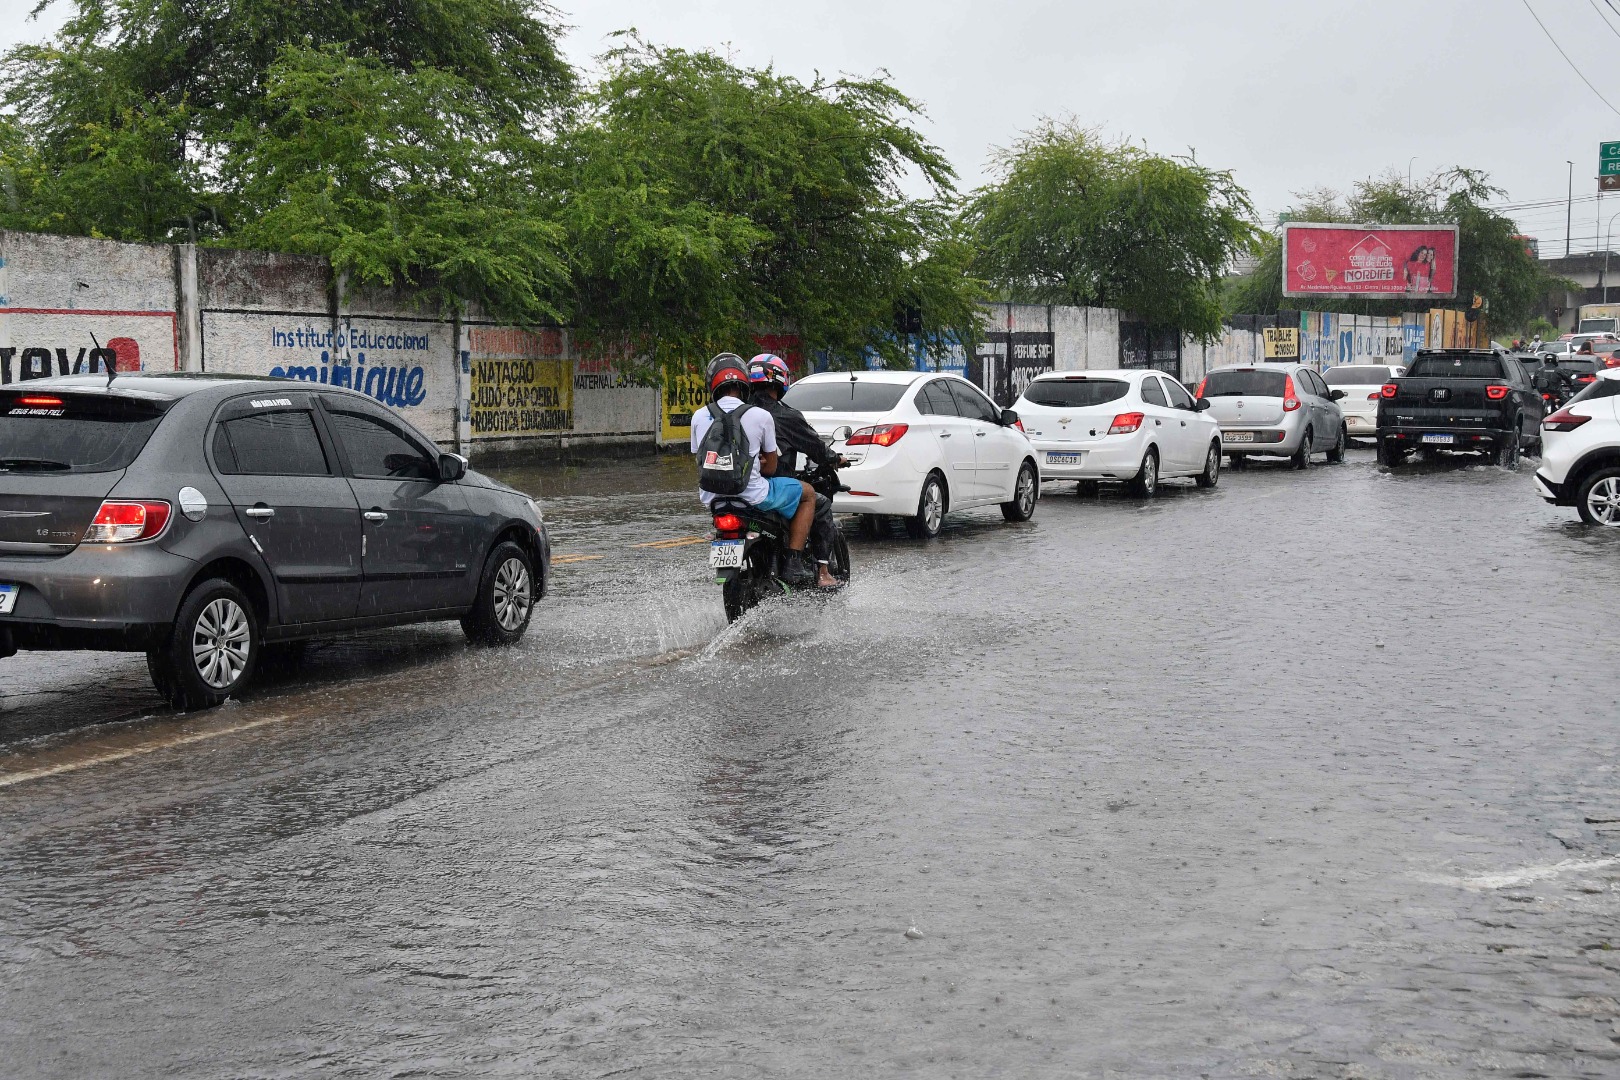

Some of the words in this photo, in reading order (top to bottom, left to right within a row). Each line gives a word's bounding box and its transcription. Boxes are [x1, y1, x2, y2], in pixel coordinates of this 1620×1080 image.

[1346, 269, 1392, 281] NORDIFE
[272, 327, 346, 347] Instituto
[350, 328, 429, 350] Educacional
[478, 359, 535, 385] NATAÇÃO
[573, 374, 614, 389] MATERNAL
[717, 546, 737, 556] SUK
[713, 556, 738, 566] 7H68
